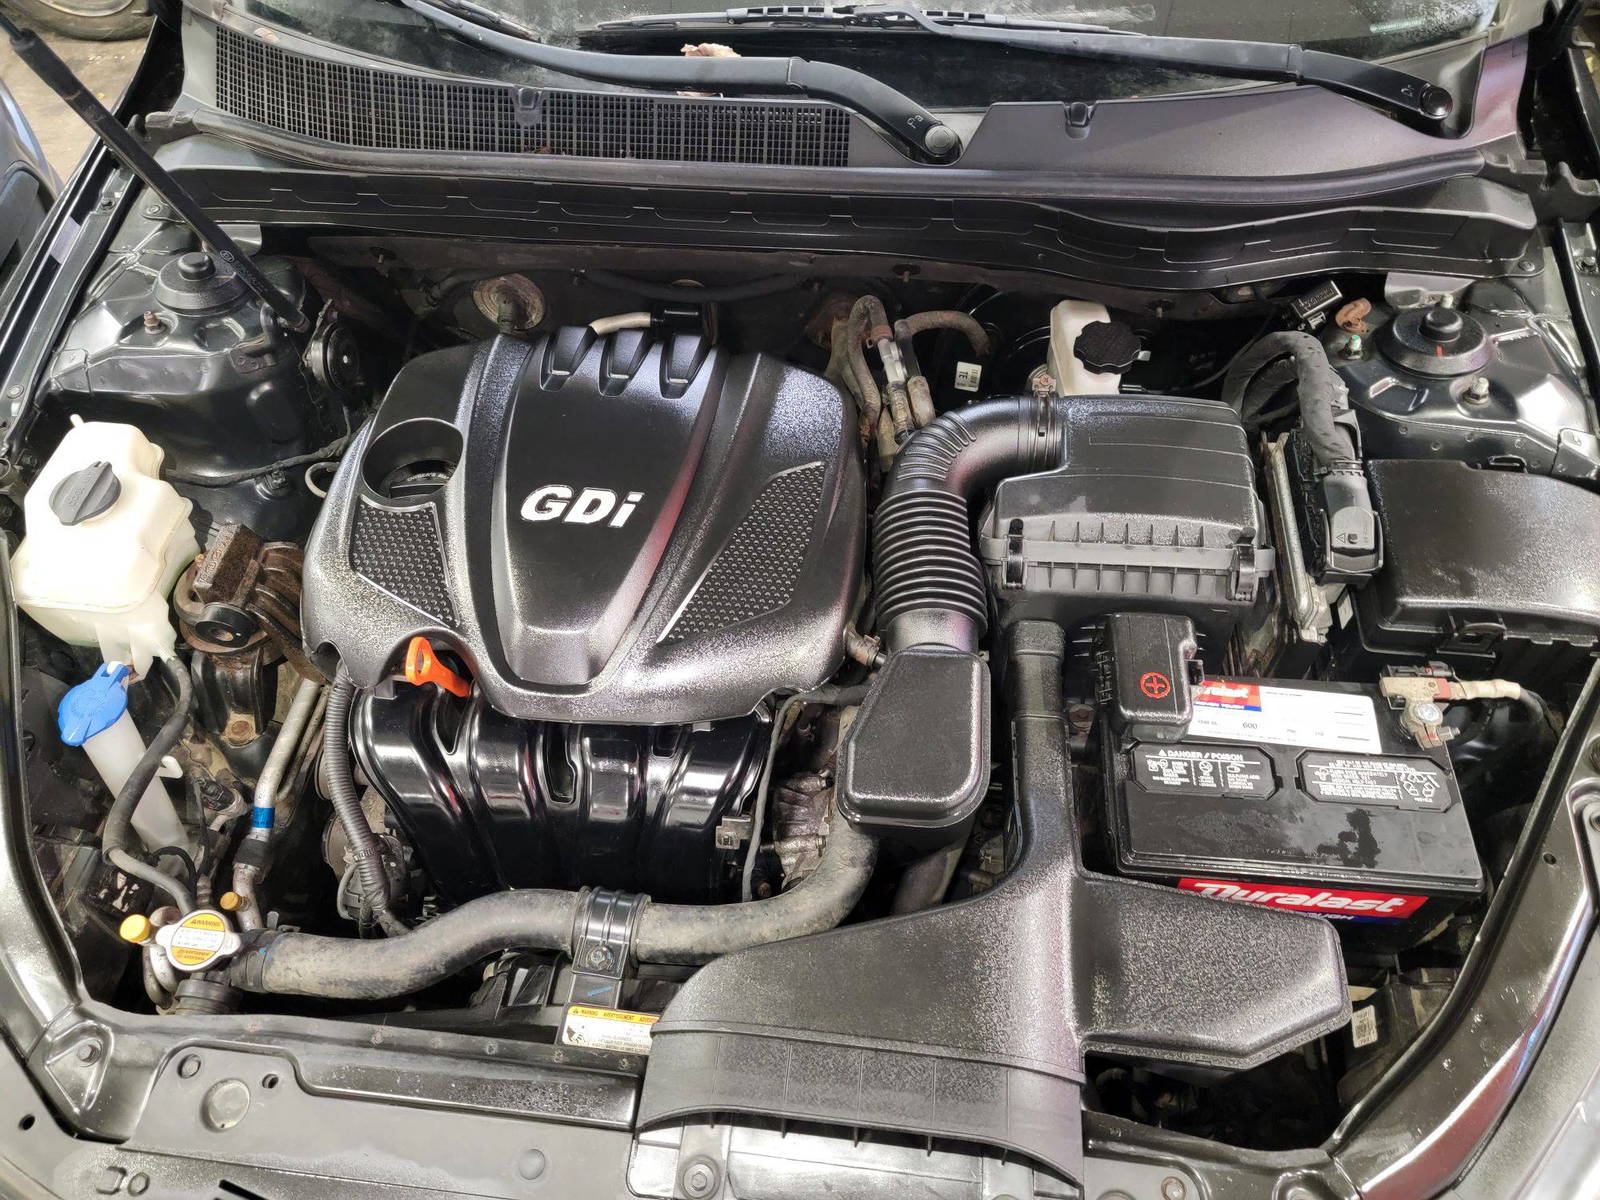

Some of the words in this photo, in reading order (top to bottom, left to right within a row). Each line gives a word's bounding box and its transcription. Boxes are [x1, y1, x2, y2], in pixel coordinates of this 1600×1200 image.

[520, 484, 645, 528] GDi
[1242, 721, 1258, 730] 600
[1167, 750, 1203, 759] DANGER
[1211, 752, 1244, 761] POISON
[1194, 883, 1405, 913] Duralast
